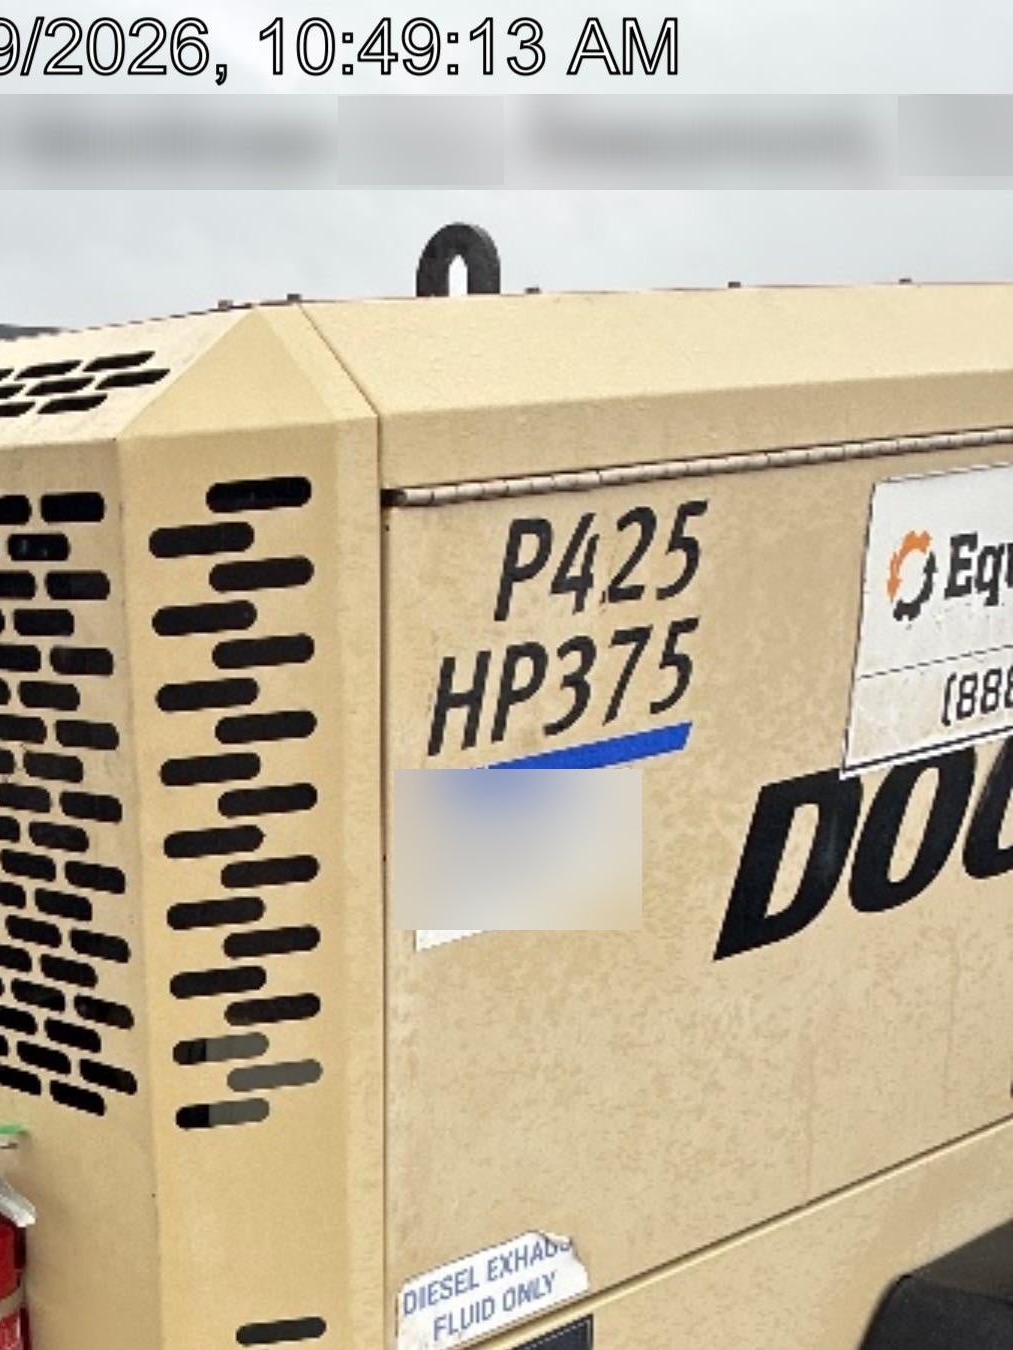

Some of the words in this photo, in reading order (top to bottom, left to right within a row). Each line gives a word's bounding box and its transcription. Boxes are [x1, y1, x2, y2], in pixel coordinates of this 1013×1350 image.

[494, 498, 710, 622] P425
[427, 617, 700, 757] HP375
[403, 1266, 480, 1317] DIESEL
[434, 1296, 495, 1341] FLUID
[502, 1269, 555, 1311] ONLY
